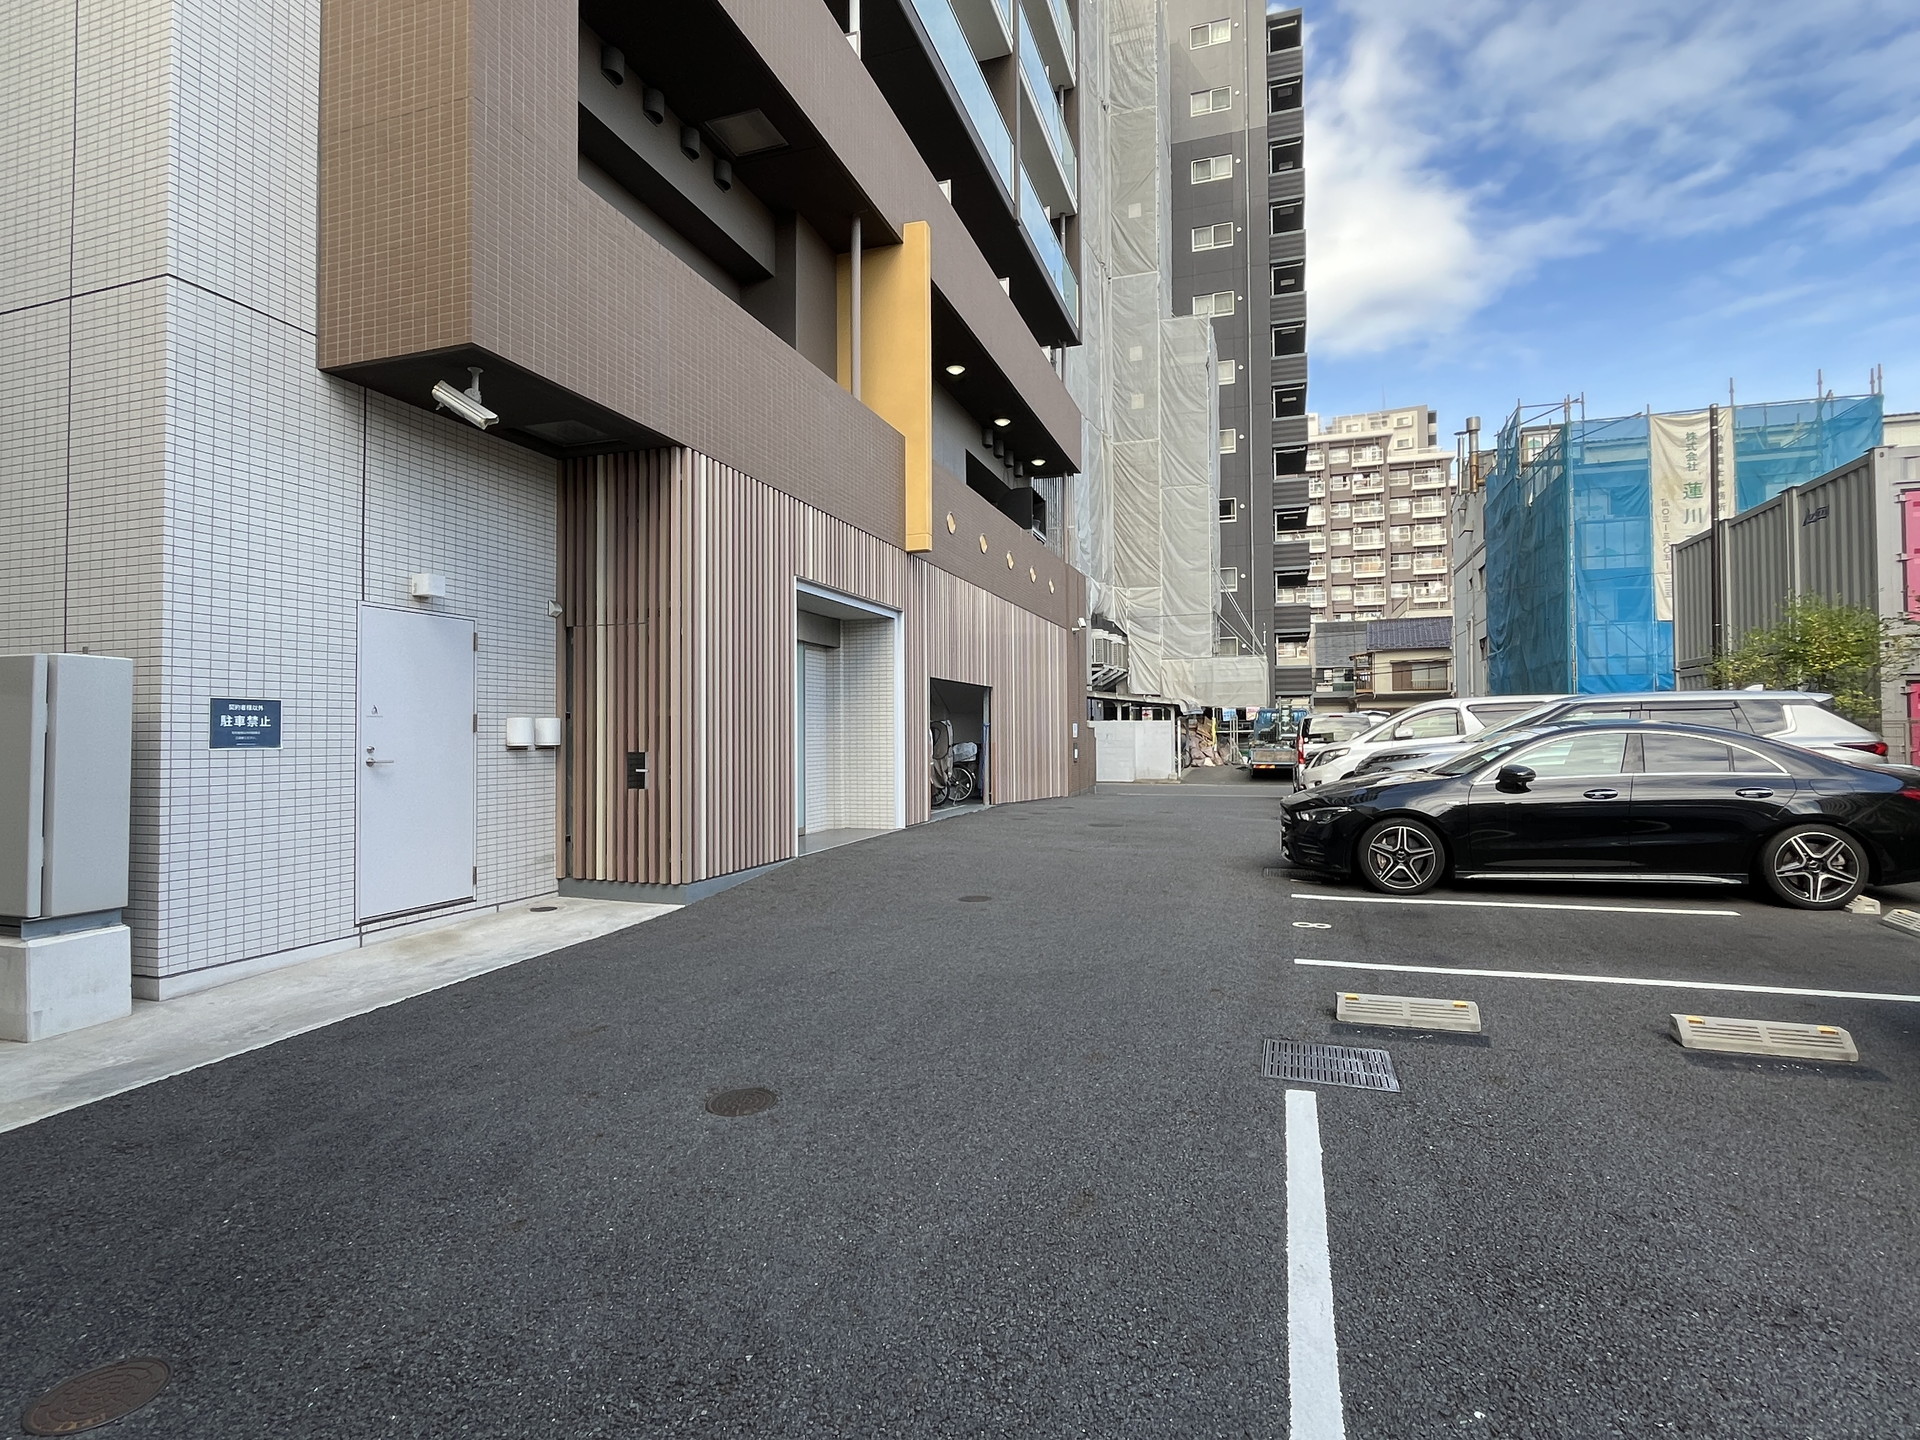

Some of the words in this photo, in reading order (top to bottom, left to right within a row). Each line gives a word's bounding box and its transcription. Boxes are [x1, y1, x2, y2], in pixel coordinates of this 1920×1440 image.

[1685, 432, 1698, 472] 株式会社
[1683, 481, 1703, 538] 蓮川
[228, 703, 264, 711] 契約者様以外
[219, 714, 272, 727] 駐車禁止
